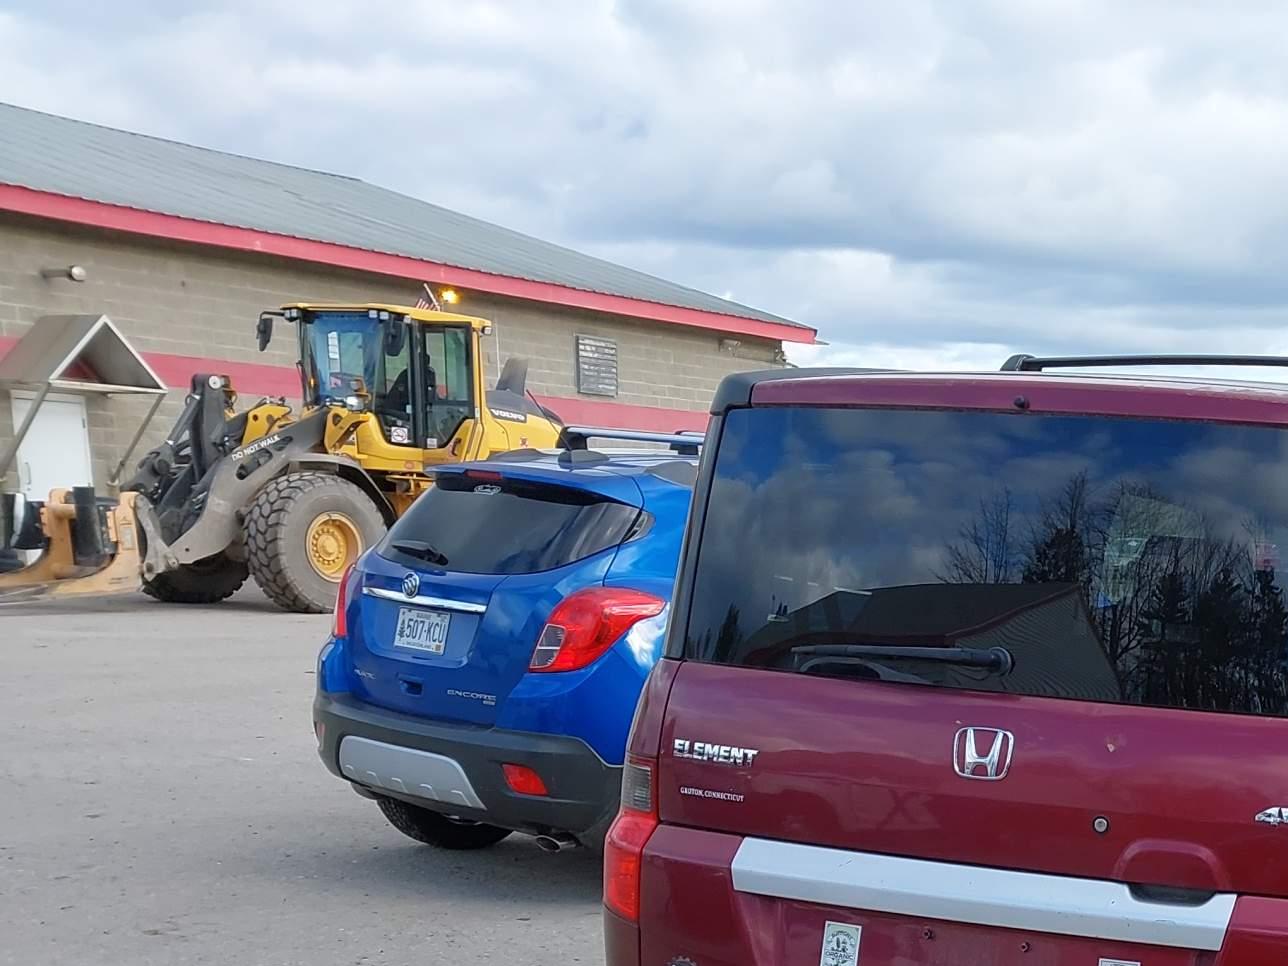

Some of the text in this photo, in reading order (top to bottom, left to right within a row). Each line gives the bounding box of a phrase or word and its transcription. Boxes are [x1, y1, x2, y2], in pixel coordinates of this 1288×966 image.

[490, 408, 526, 421] VOLVO
[231, 434, 281, 462] DO NOT WALK
[447, 689, 497, 701] ENCORE
[673, 738, 759, 767] ELEMENT
[704, 790, 744, 802] CONNECTICUT
